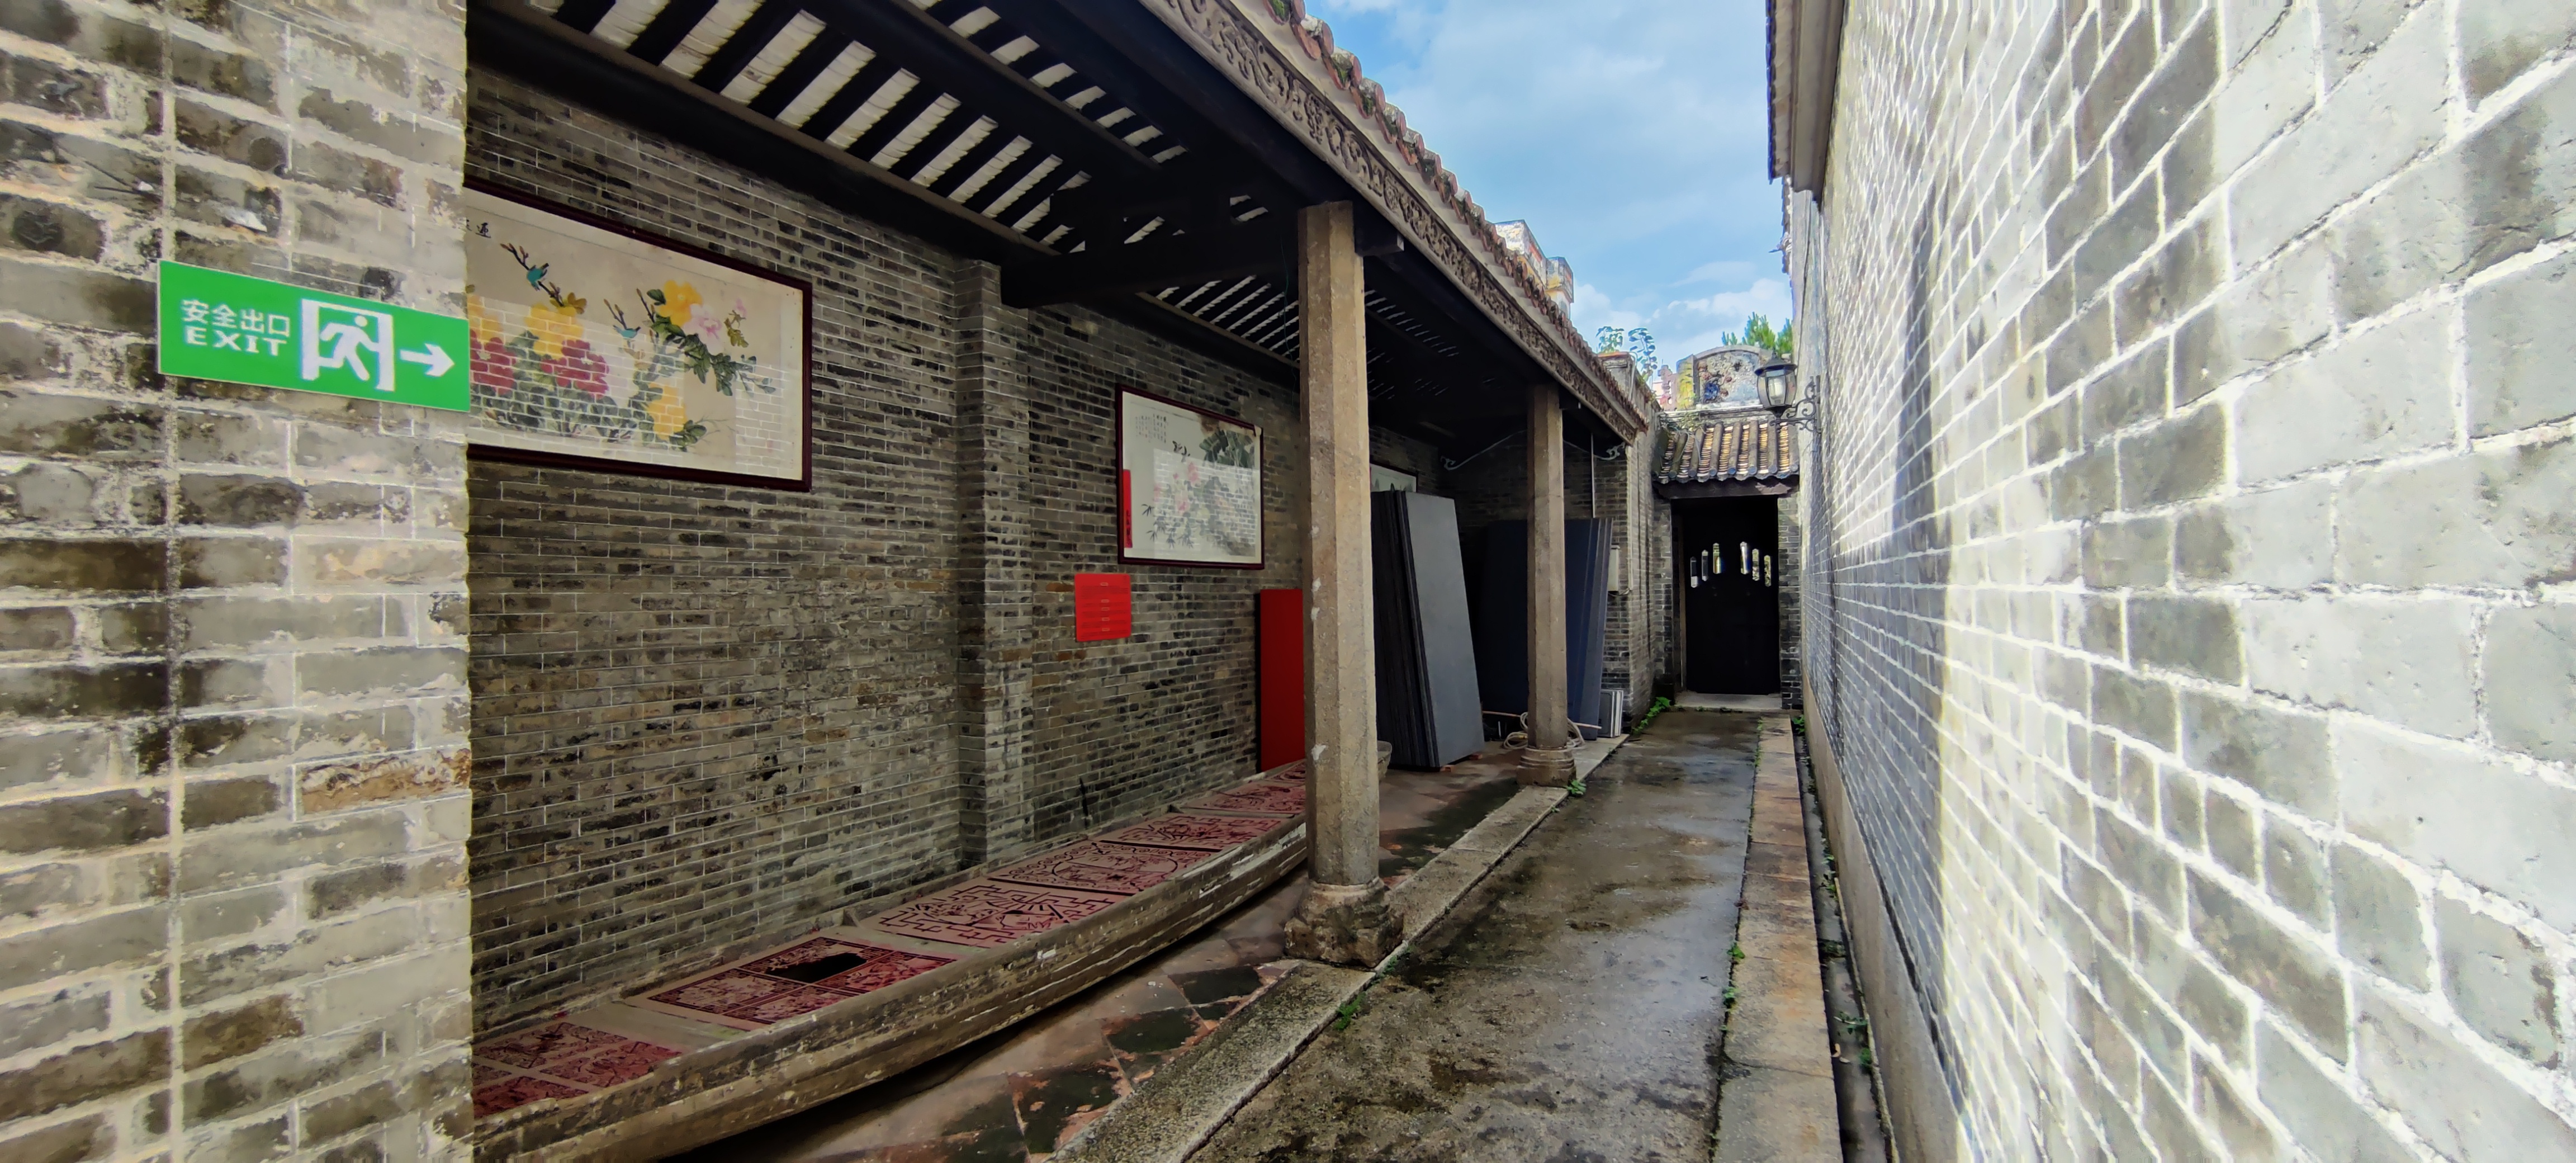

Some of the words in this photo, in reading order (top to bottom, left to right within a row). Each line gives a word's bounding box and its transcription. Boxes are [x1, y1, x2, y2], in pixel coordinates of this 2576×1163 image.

[182, 299, 290, 338] 安全出口
[185, 325, 287, 356] EXIT
